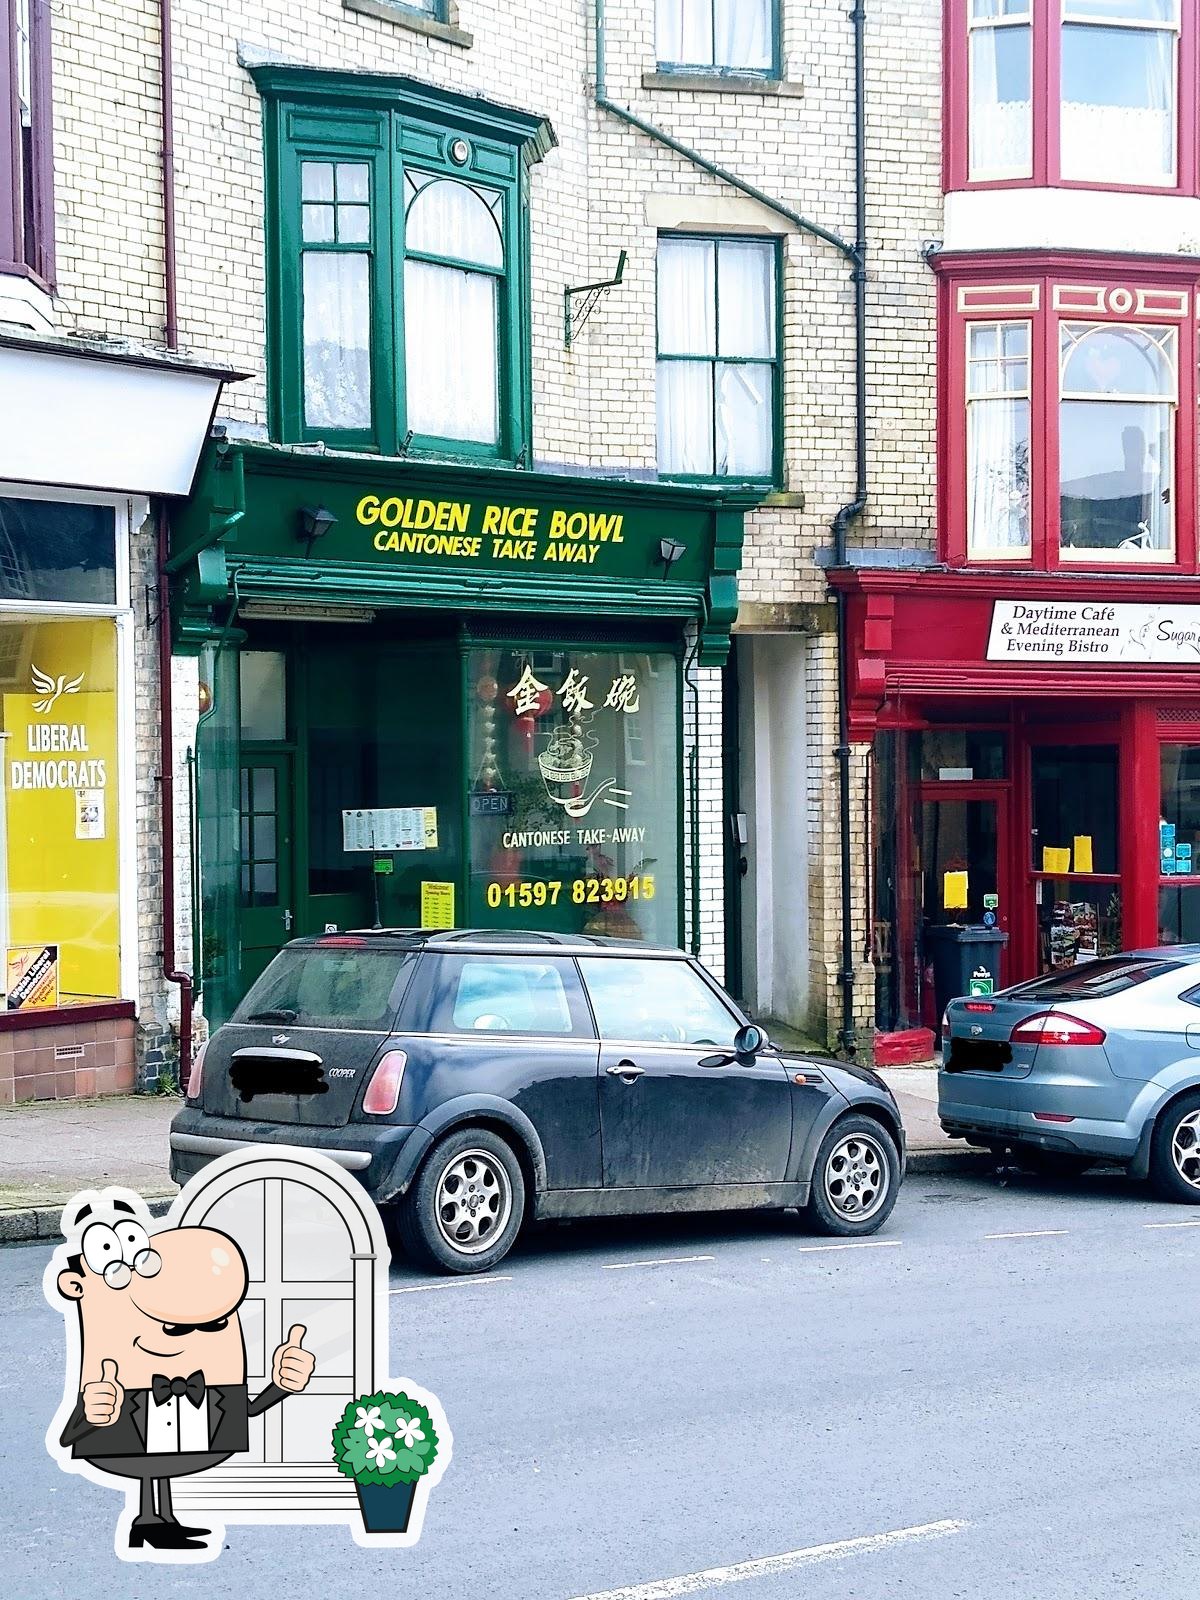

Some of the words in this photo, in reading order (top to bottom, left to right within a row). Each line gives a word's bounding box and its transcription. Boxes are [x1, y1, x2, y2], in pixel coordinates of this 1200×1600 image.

[356, 495, 471, 533] GOLDEN
[481, 505, 539, 537] RICE
[549, 510, 624, 543] BOWL
[373, 530, 482, 557] CANTONESE
[492, 538, 538, 561] TAKE
[543, 542, 600, 564] AWAY
[1012, 605, 1077, 623] Daytime
[1081, 606, 1115, 621] Café
[1000, 622, 1013, 635] &
[1017, 622, 1120, 637] Mediterranean
[1156, 619, 1196, 646] Sugar
[1007, 638, 1063, 656] Evening
[1068, 639, 1109, 653] Bistro
[27, 724, 89, 752] LIBERAL
[11, 759, 107, 790] DEMOCRATS
[472, 796, 508, 811] OPEN
[502, 830, 571, 848] CANTONESE
[487, 881, 562, 908] 01597
[572, 875, 656, 904] 823915
[328, 1067, 356, 1079] COOPER
